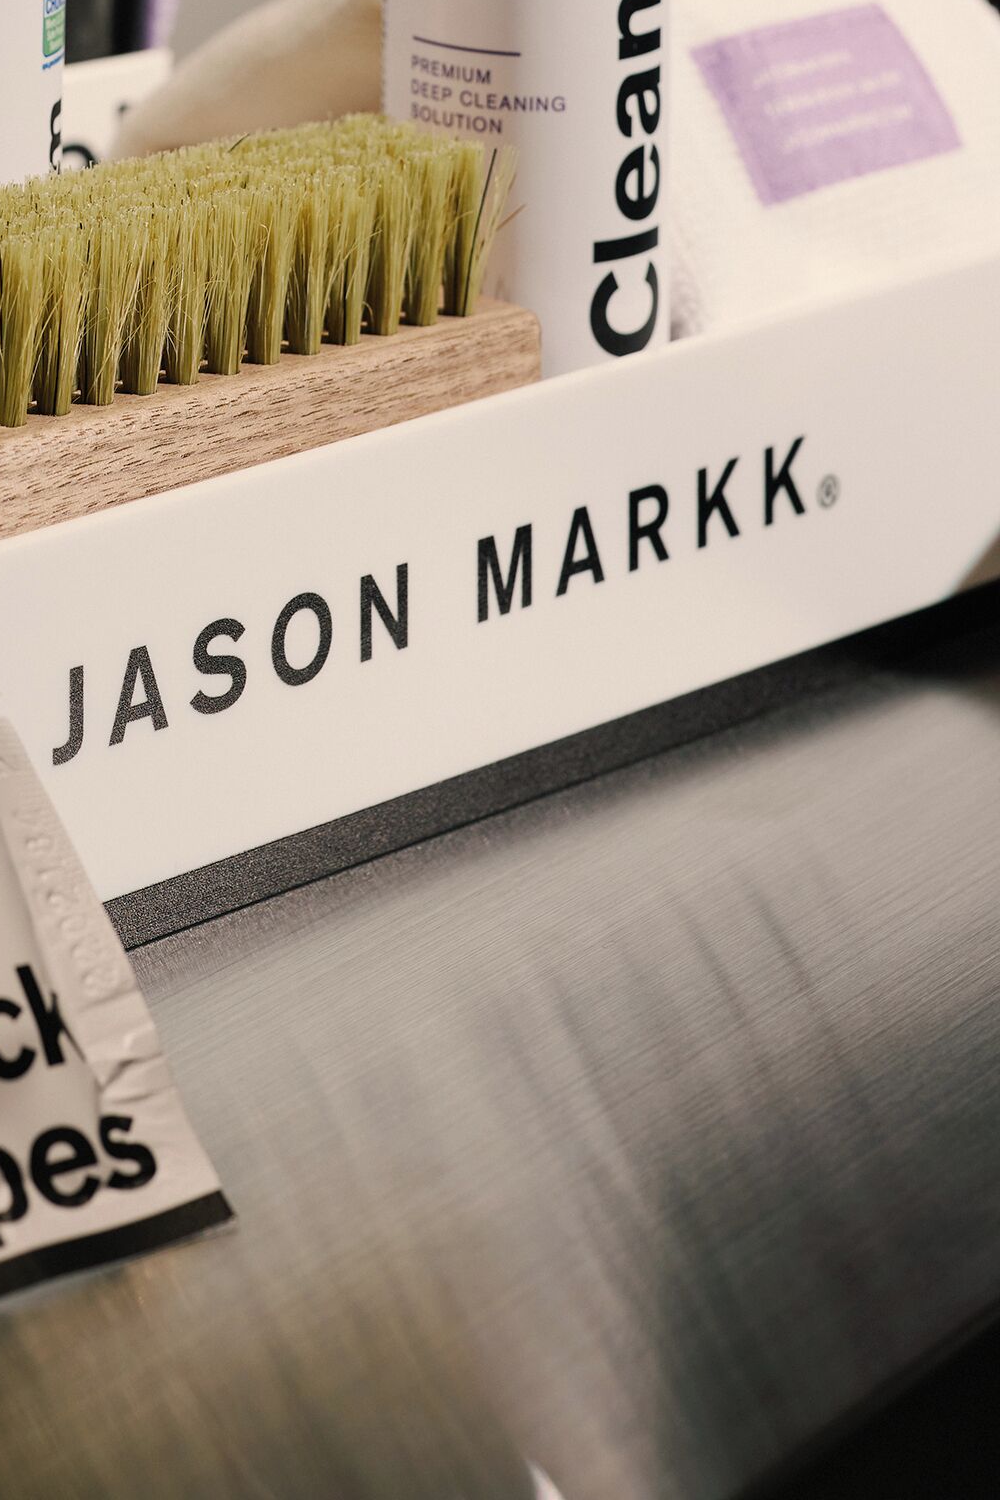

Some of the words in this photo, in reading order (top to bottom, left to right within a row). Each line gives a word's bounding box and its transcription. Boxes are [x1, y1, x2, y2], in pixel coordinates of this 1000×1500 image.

[411, 55, 491, 85] PREMIUM
[411, 79, 452, 99] DEEP
[459, 91, 566, 113] CLEANING
[411, 103, 503, 134] SOLUTION
[52, 561, 410, 766] JASON
